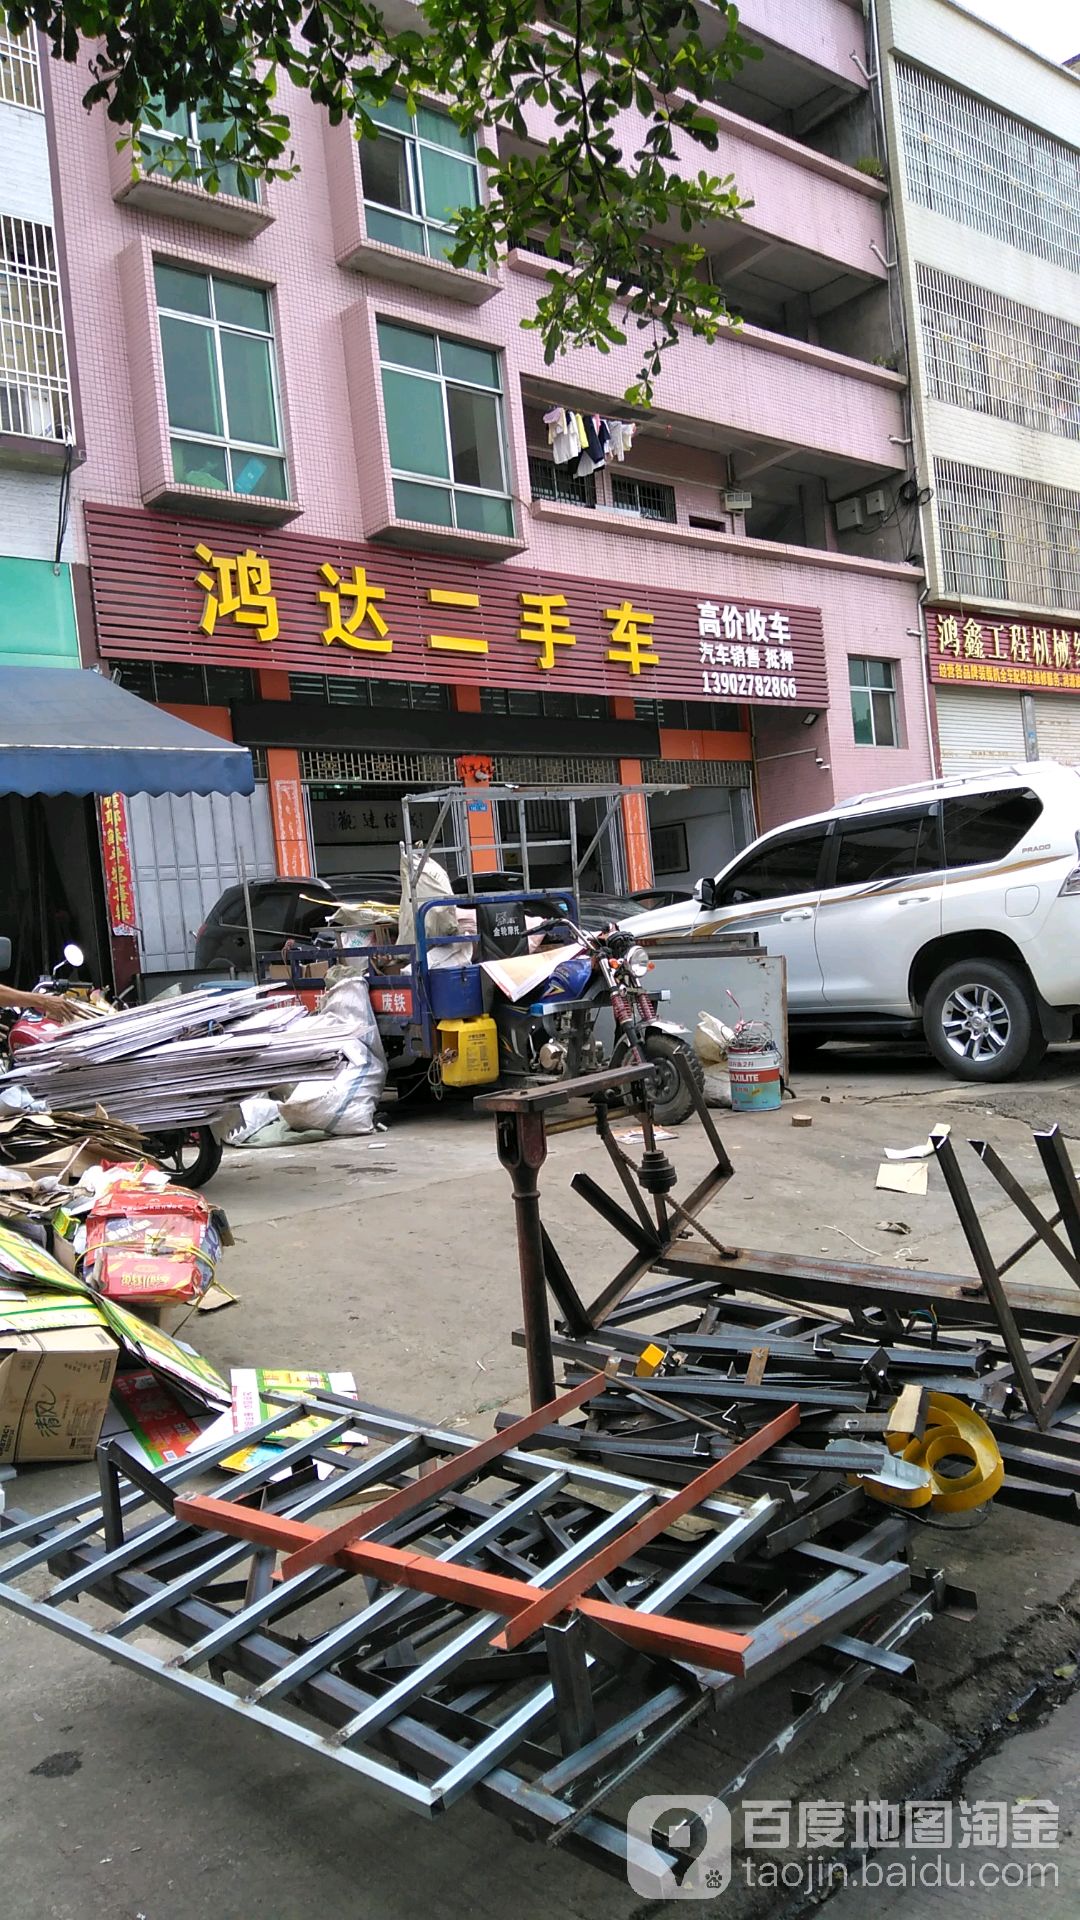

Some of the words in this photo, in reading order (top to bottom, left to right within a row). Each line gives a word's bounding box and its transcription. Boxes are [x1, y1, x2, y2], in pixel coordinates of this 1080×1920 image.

[193, 542, 660, 675] 鸿达二手车
[697, 600, 791, 645] 高价收车
[699, 640, 761, 669] 汽车销售
[765, 648, 795, 673] 抵押
[701, 671, 797, 699] 13902782866
[1021, 844, 1052, 855] PRADO
[493, 925, 520, 937] 金轮摩托
[381, 991, 406, 1013] 废铁
[730, 1073, 760, 1083] AXILITE
[34, 1383, 62, 1439] 清风
